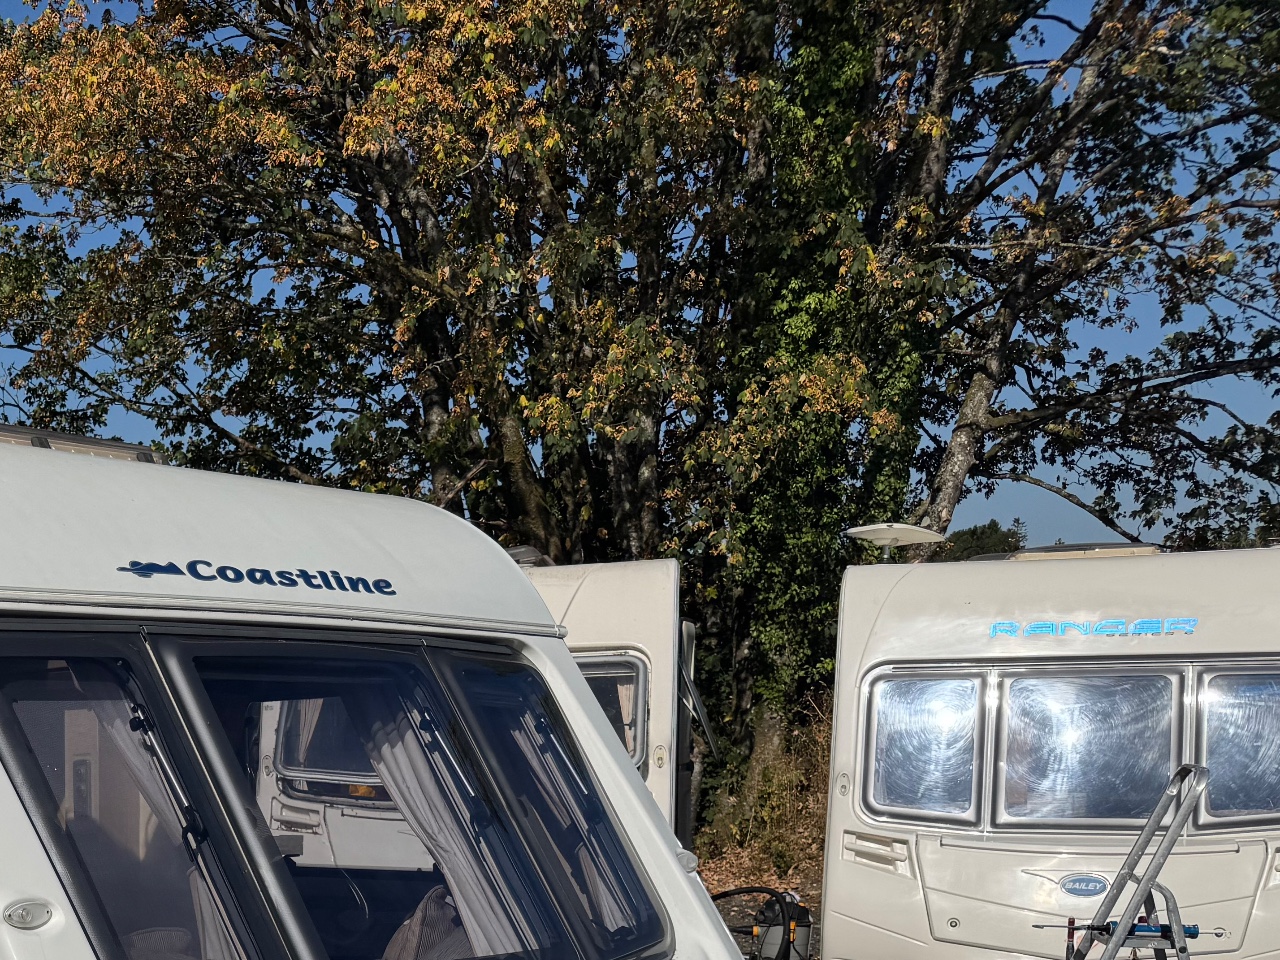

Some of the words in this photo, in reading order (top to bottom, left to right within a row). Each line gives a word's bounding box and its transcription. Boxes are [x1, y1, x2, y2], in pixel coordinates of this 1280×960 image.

[185, 558, 398, 597] Coastline
[989, 617, 1199, 639] RANGER
[1064, 881, 1104, 890] BAILEY
